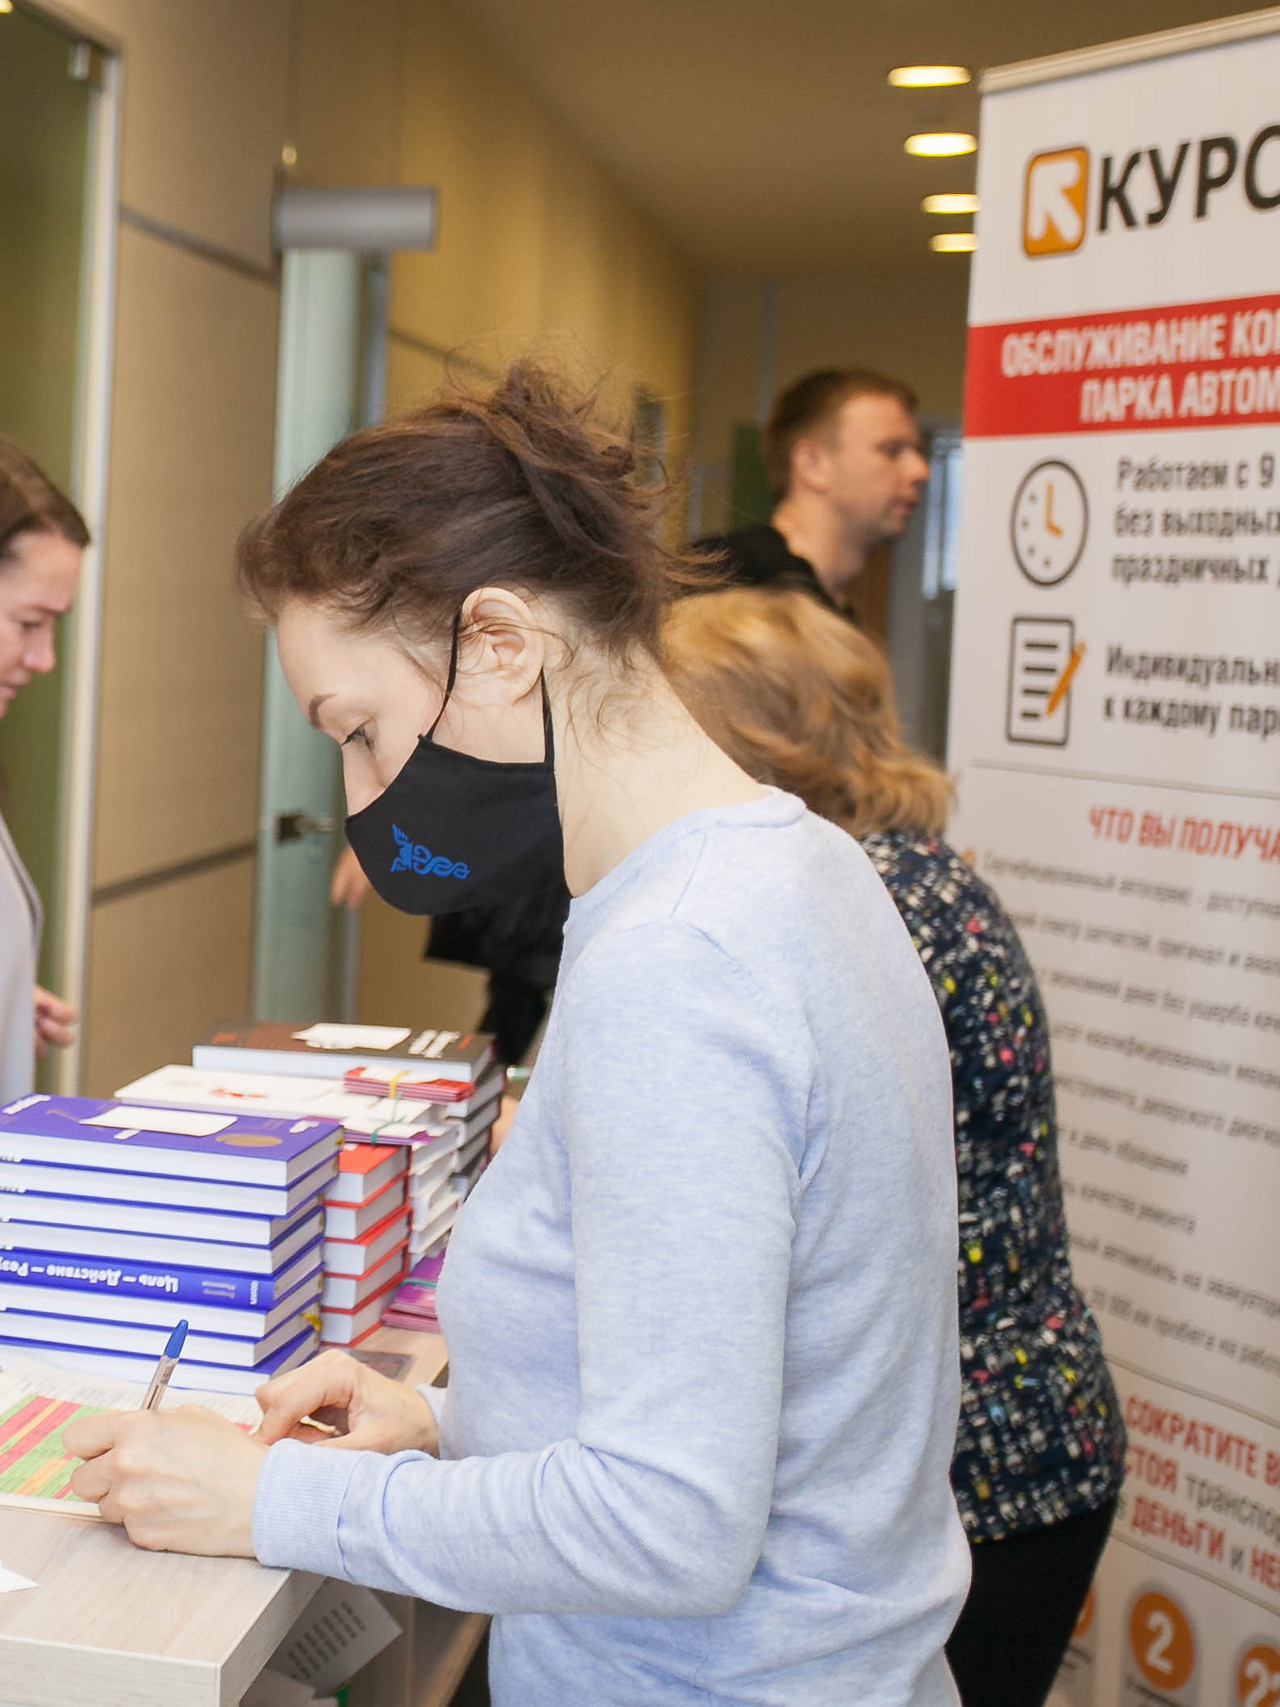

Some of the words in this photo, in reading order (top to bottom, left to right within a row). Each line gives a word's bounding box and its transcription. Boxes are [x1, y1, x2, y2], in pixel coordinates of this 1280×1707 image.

[1000, 312, 1226, 379] ОБСЛУЖИВАНИЕ
[1230, 307, 1280, 359] КО
[1080, 373, 1174, 424] ПАРКА
[1117, 456, 1228, 492] Работаем
[1236, 460, 1249, 489] с
[1260, 449, 1275, 489] 9
[1115, 501, 1153, 538] без
[1111, 554, 1270, 588] праздничных
[1104, 696, 1115, 721] к
[1122, 698, 1221, 738] каждому
[1228, 704, 1280, 742] пар
[1088, 805, 1135, 844] ЧТО
[1138, 811, 1177, 849] ВЫ
[45, 1263, 122, 1288] Действие
[138, 1273, 180, 1294] Цель
[1125, 1394, 1259, 1479] СОКРАТИТЕ
[1131, 1495, 1224, 1564] ДЕНЬГИ
[1146, 1610, 1174, 1675] 2
